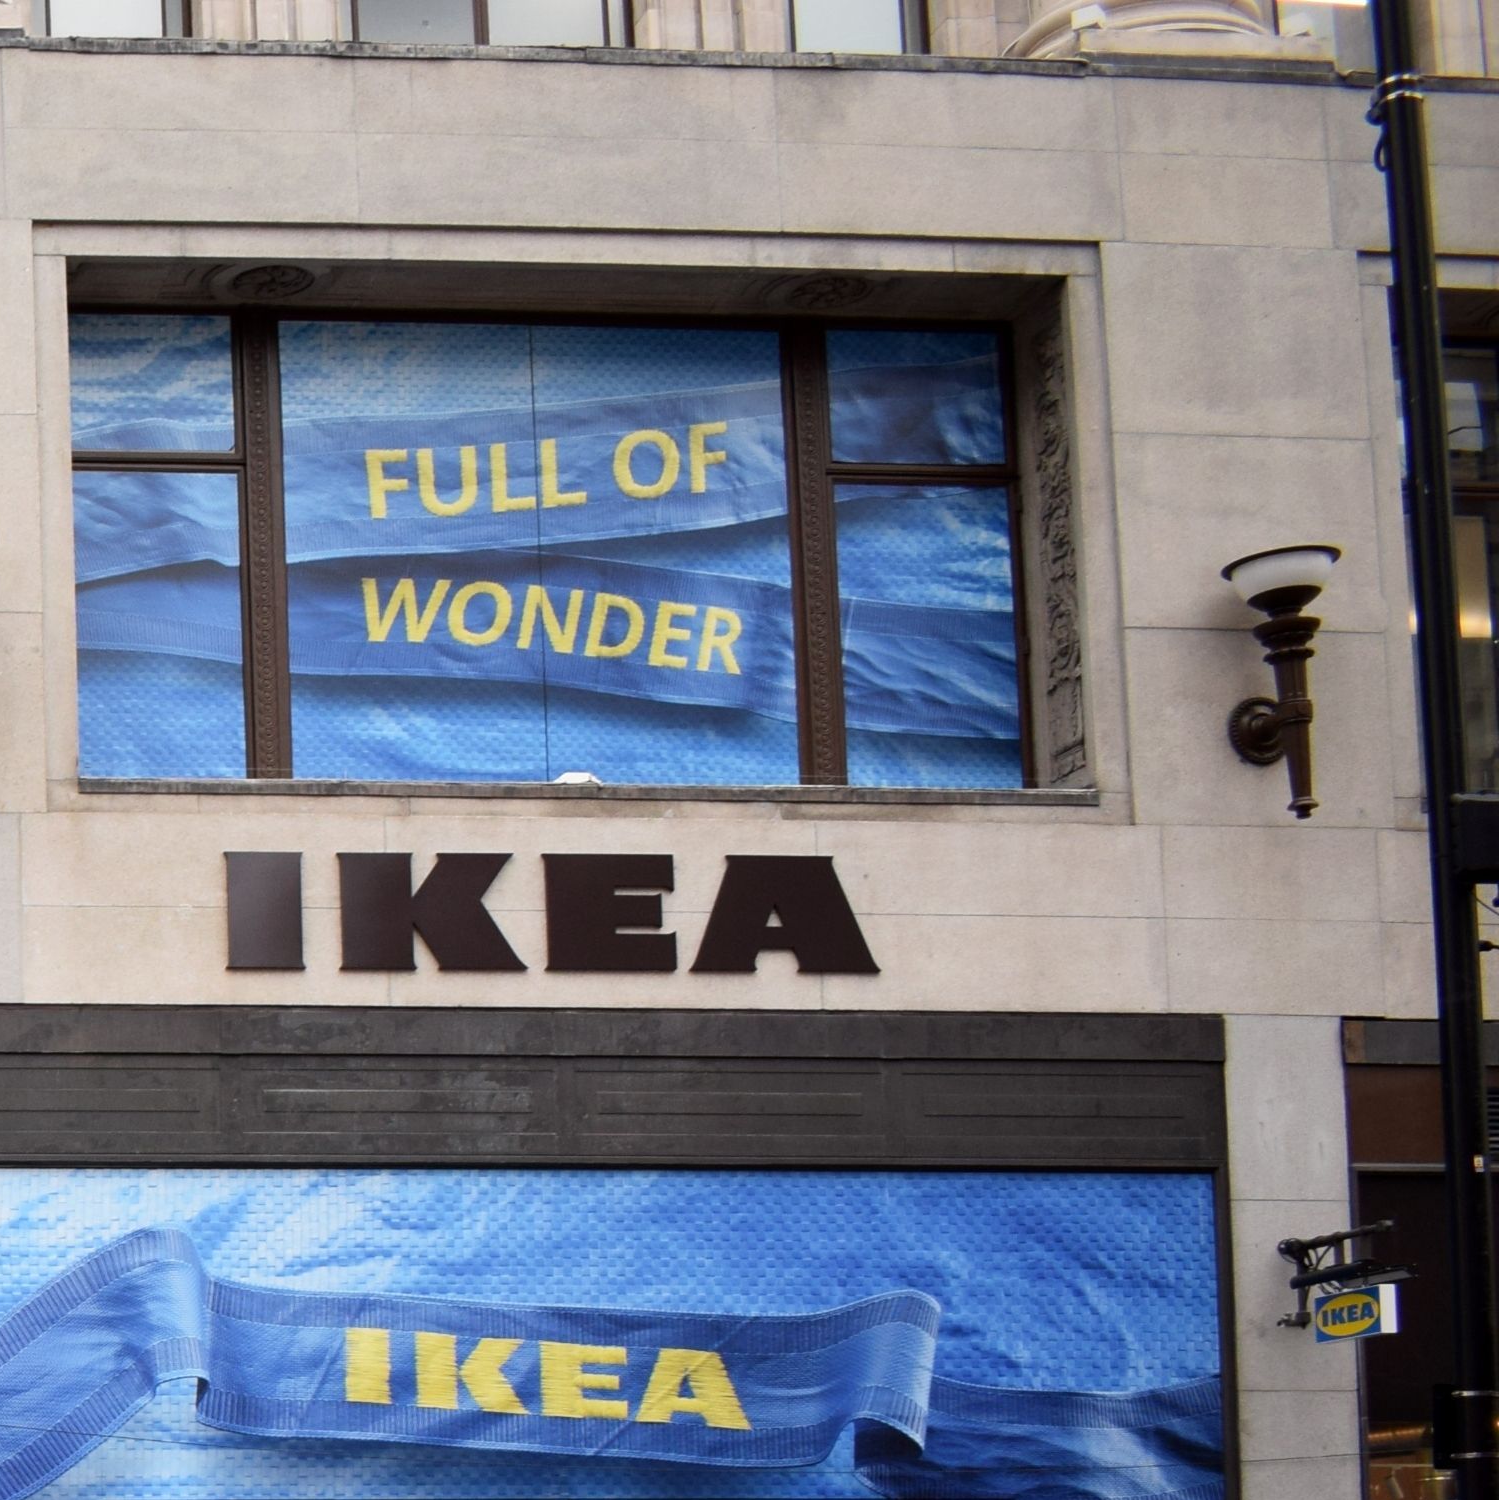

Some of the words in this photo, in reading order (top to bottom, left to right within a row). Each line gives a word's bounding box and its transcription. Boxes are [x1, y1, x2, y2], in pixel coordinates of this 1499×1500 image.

[364, 436, 588, 520] FULL
[612, 421, 728, 500] OF
[361, 577, 743, 676] WONDER
[223, 851, 881, 974] IKEA
[1321, 1301, 1376, 1328] IKEA
[344, 1326, 752, 1430] IKEA
